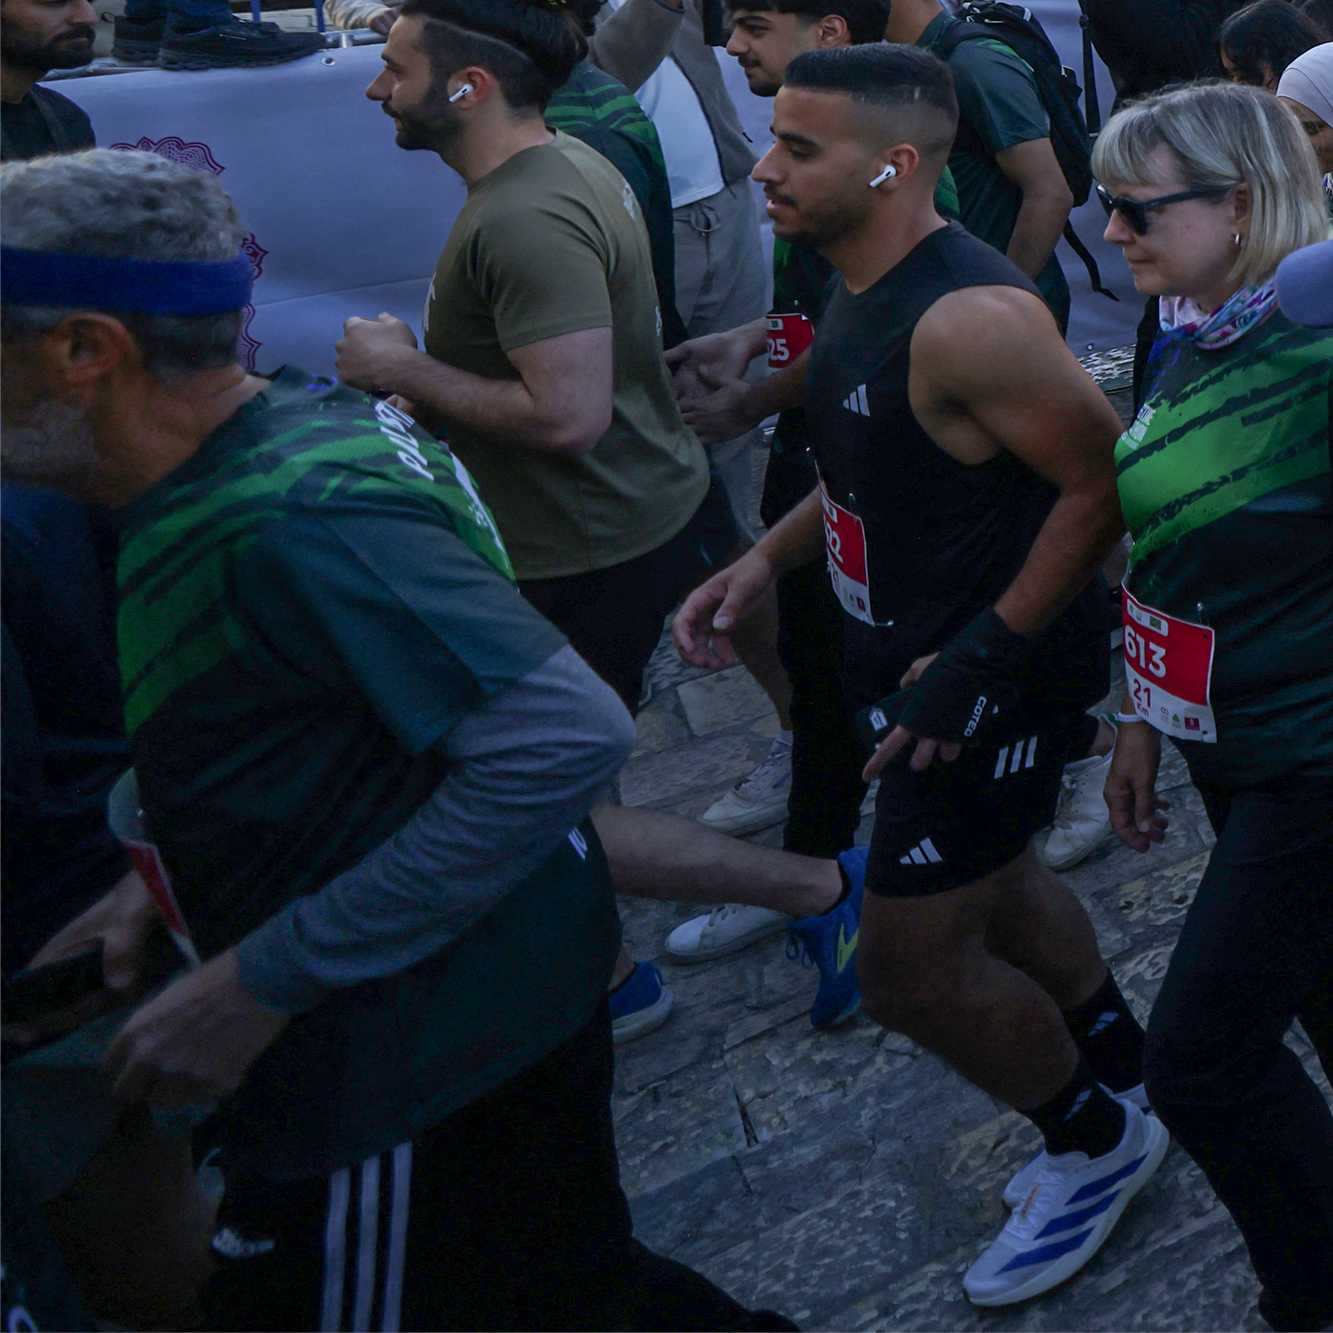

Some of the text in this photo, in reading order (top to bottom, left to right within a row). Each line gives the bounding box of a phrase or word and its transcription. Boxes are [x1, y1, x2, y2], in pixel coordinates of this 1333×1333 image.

[1124, 625, 1166, 678] 613
[1133, 678, 1151, 708] 21
[1136, 701, 1149, 717] Km
